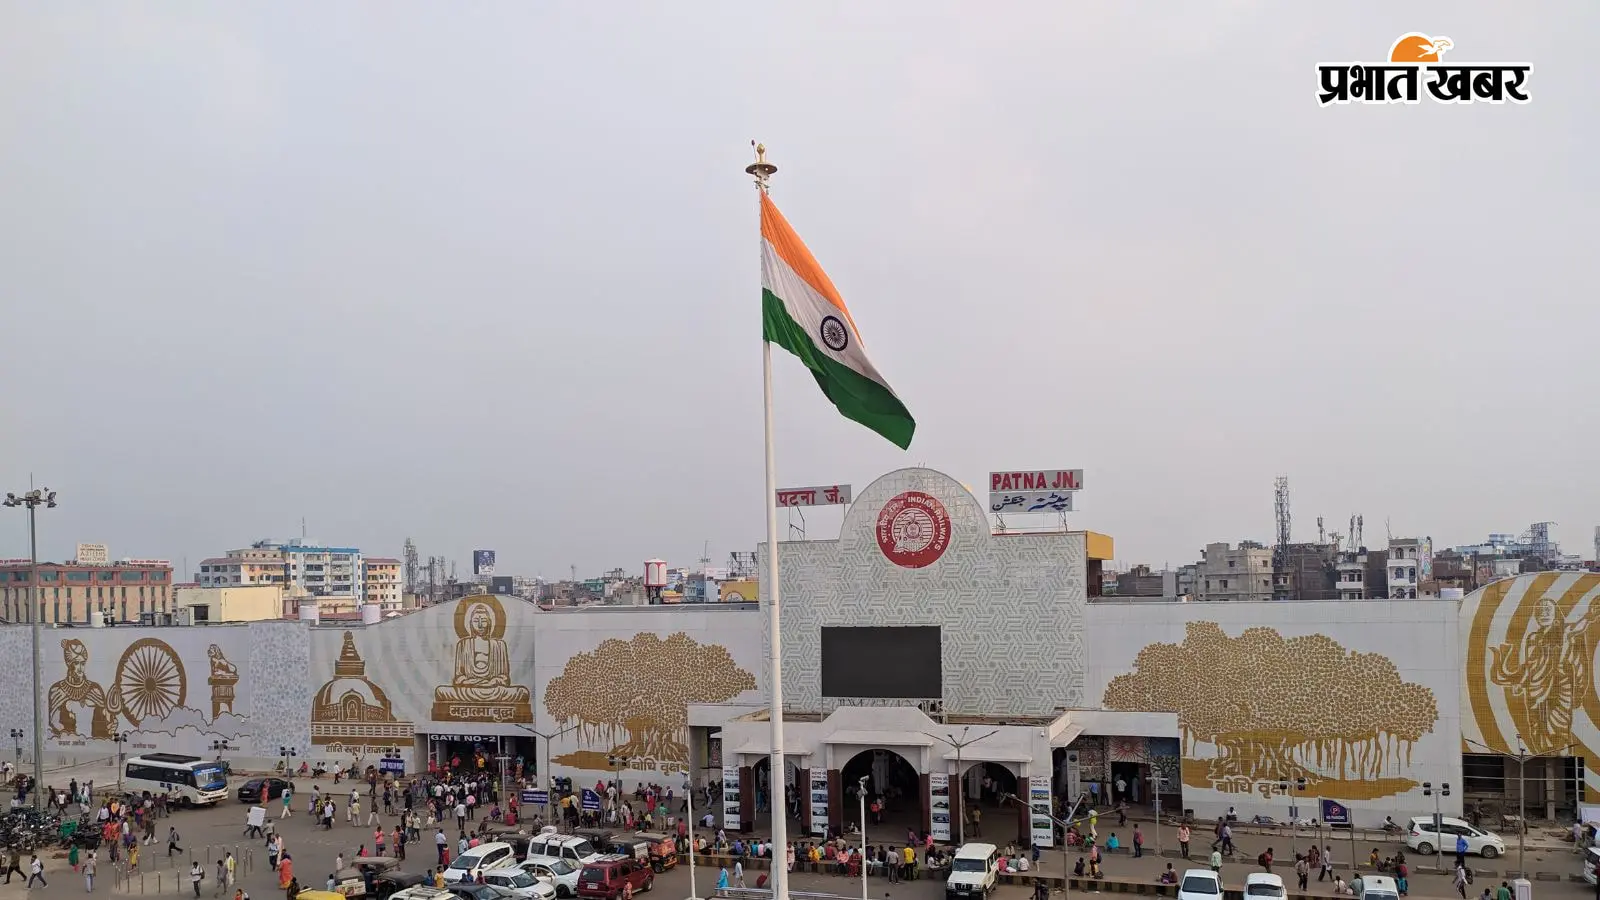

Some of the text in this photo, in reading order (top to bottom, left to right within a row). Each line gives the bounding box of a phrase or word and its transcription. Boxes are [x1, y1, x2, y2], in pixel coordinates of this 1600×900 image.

[992, 471, 1080, 490] PATNA JN.
[777, 490, 817, 507] पटना
[907, 496, 947, 551] INDIAN RAILWAYS
[450, 706, 515, 721] महात्मा बुद्ध
[325, 742, 343, 753] शांति
[344, 744, 361, 757] स्तूप
[631, 757, 680, 776] बोधि वृक्ष
[1215, 776, 1253, 794] बोधि
